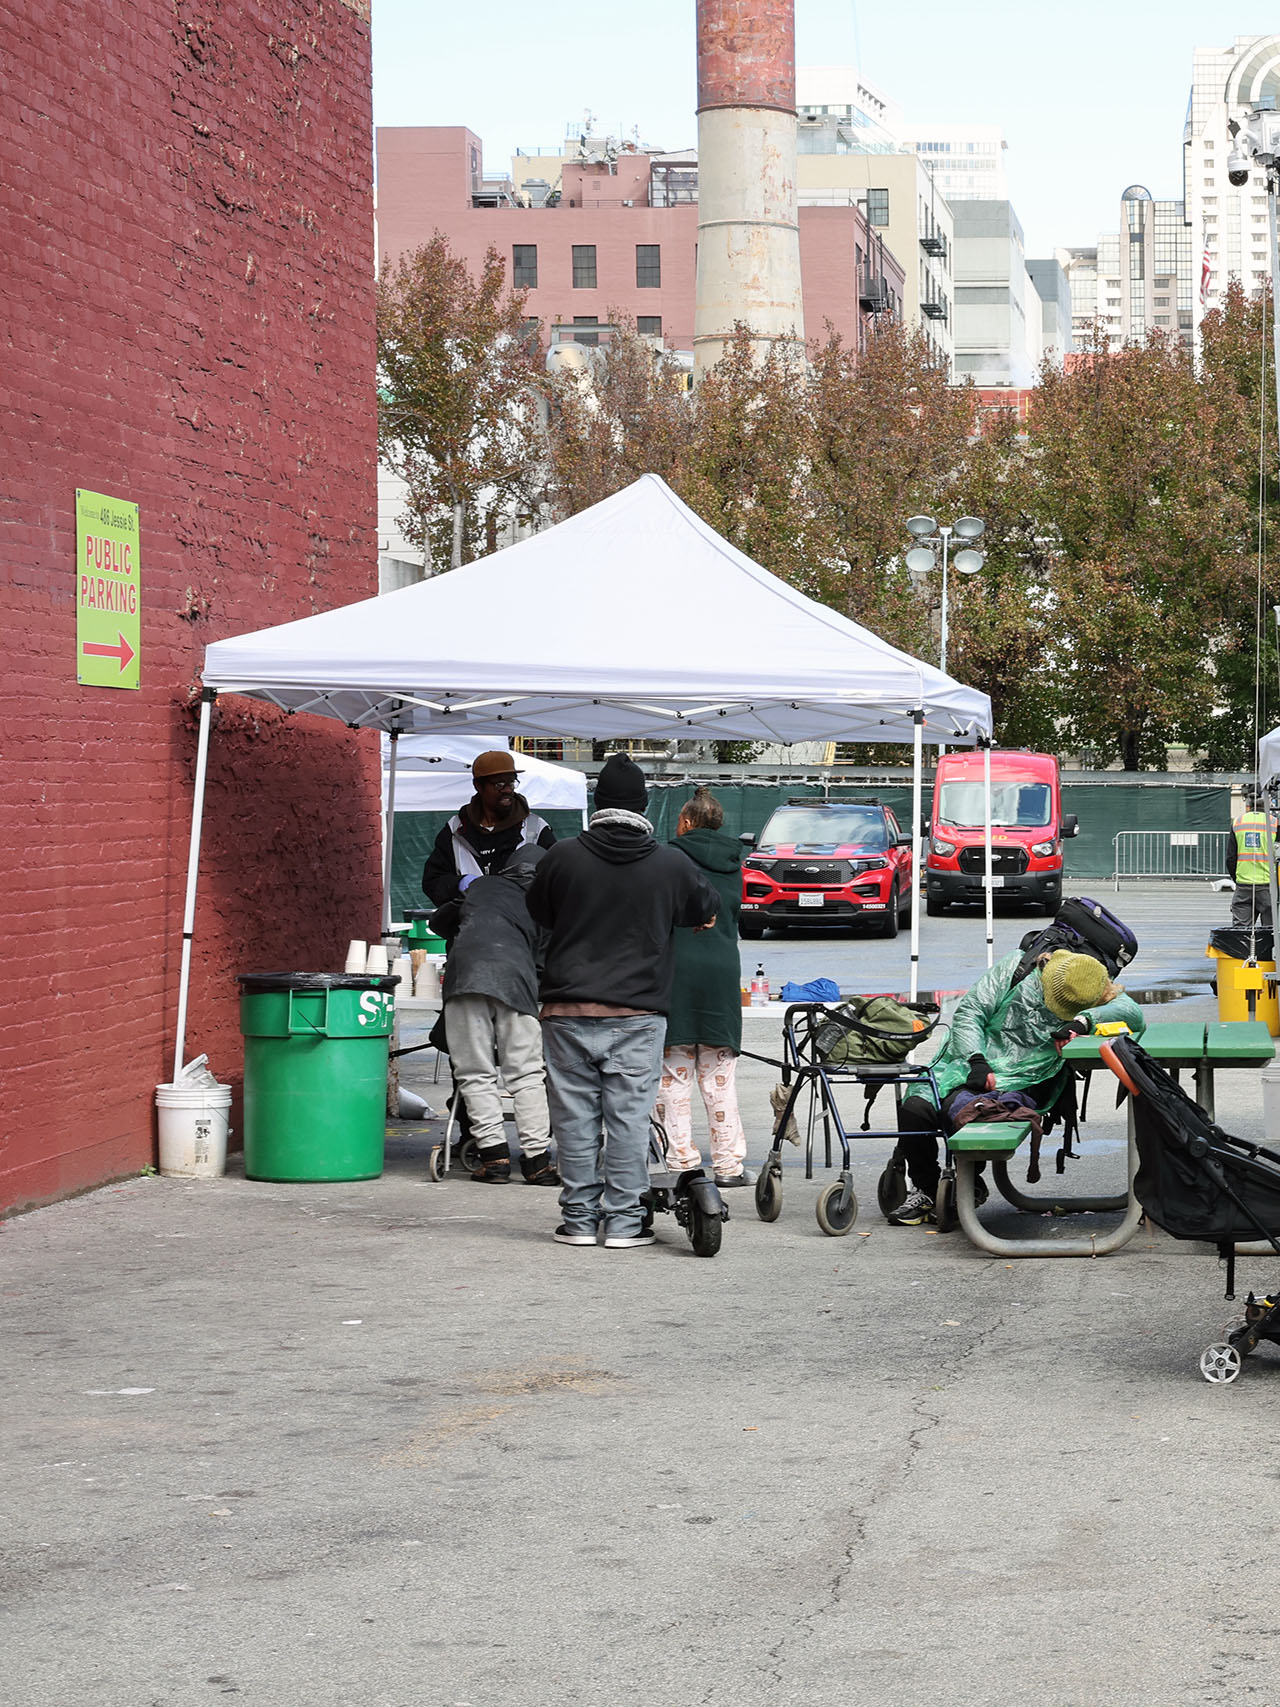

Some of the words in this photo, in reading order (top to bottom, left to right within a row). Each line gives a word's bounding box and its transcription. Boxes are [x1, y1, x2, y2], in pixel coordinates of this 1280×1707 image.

[111, 510, 127, 530] Jessie
[86, 534, 131, 575] PUBLIC
[80, 575, 136, 615] PARKING
